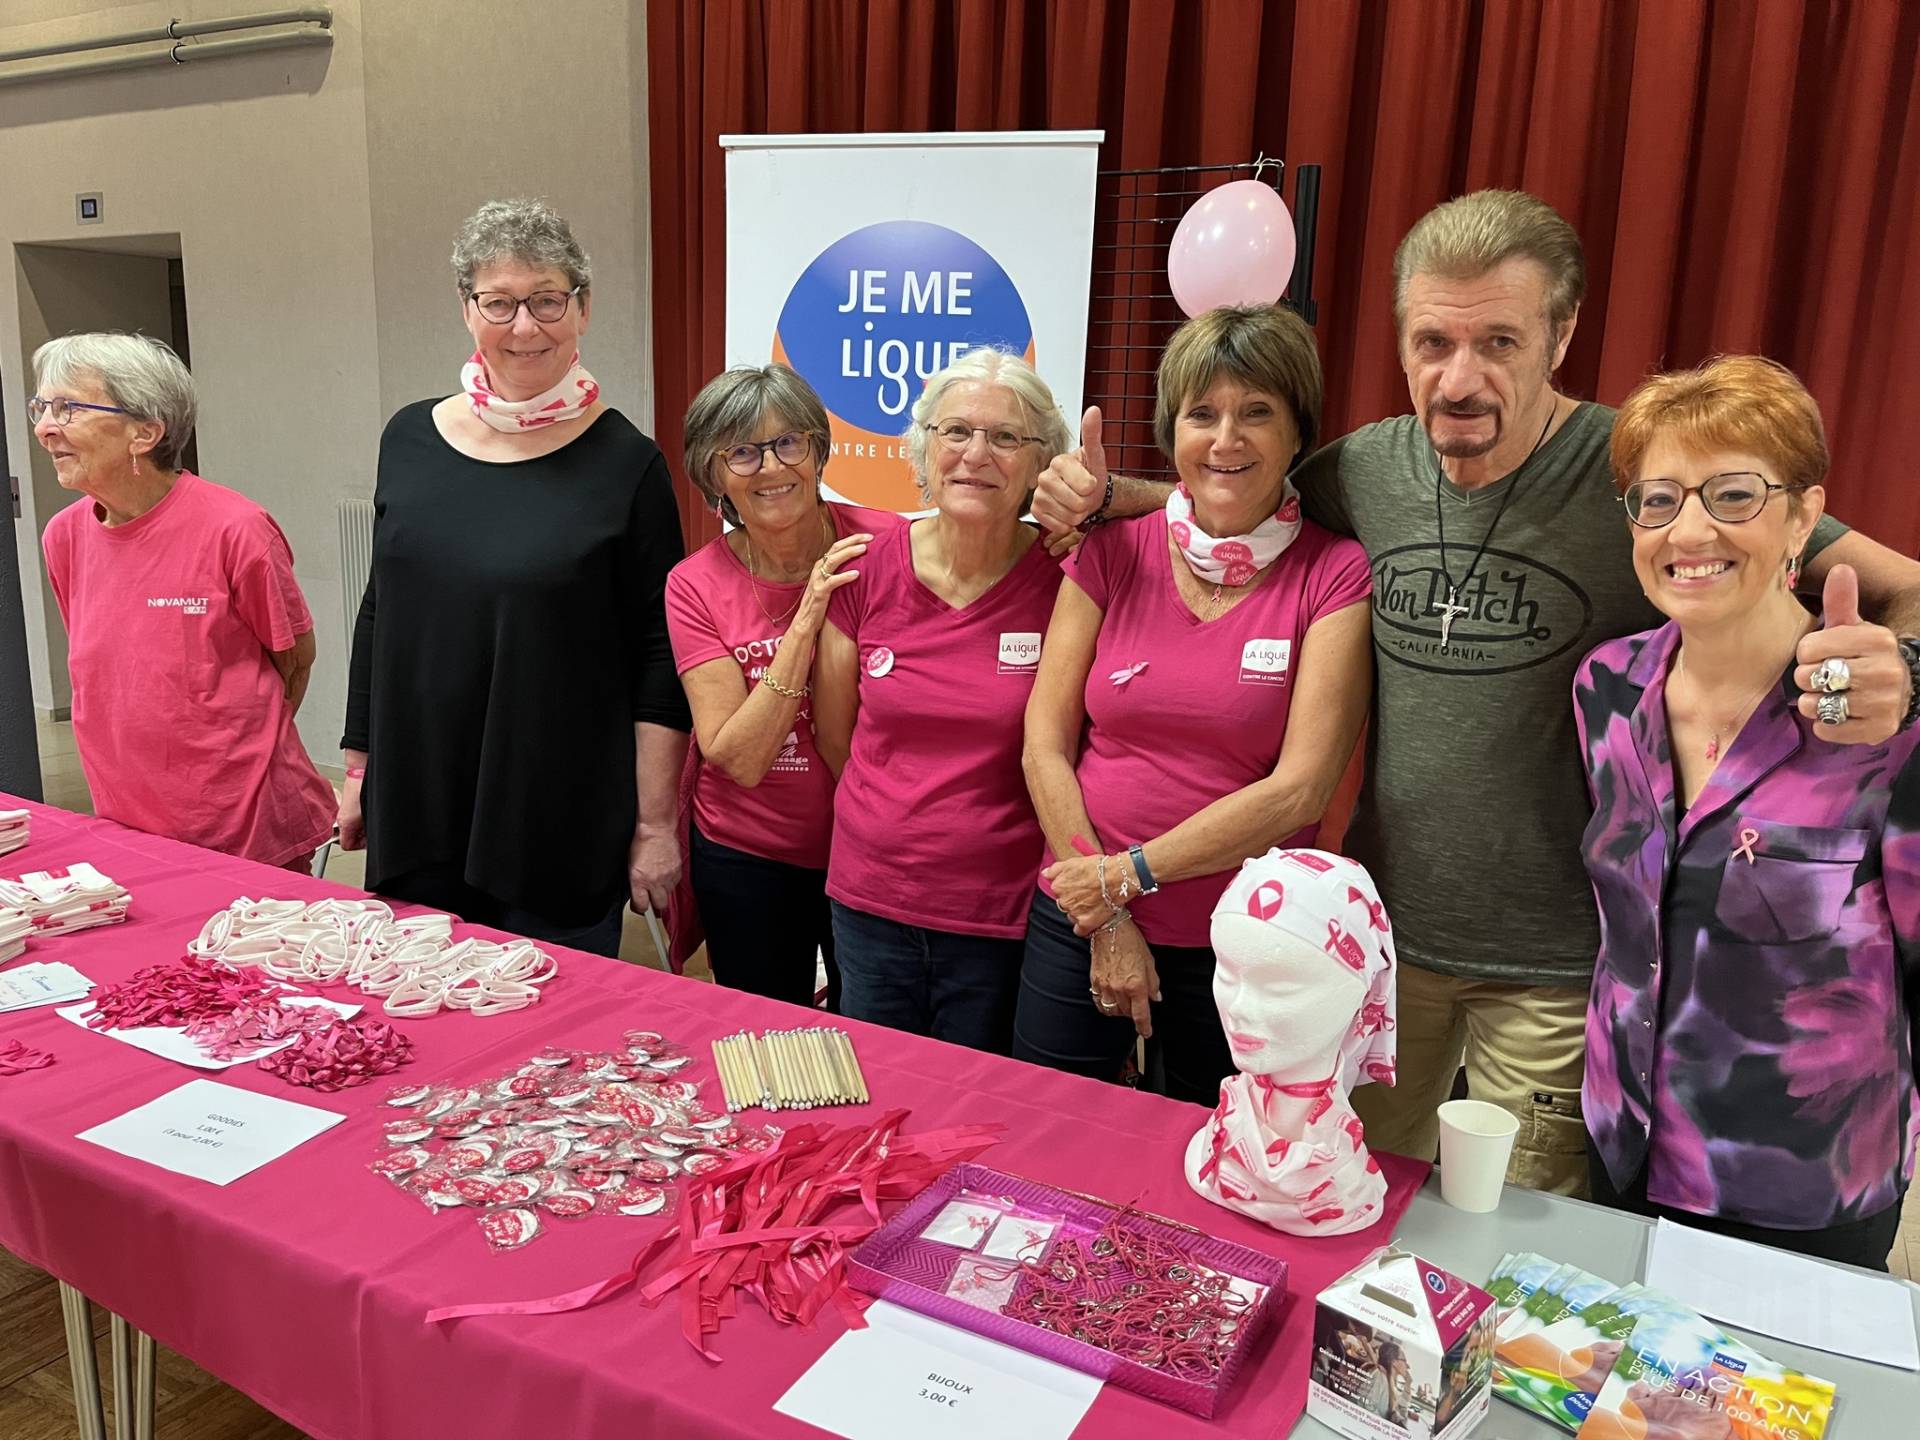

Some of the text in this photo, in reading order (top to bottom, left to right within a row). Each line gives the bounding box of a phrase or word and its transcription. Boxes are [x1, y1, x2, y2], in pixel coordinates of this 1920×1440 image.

[838, 270, 973, 315] JE ME
[829, 442, 908, 459] NTRE LE
[1375, 561, 1419, 621] Von
[147, 597, 209, 608] NOVAMUT
[1001, 644, 1012, 653] LA
[1245, 650, 1257, 659] LA
[207, 1113, 246, 1128] GOODIES
[1632, 1359, 1681, 1385] DEPUIS
[927, 1372, 974, 1395] BIJOUX
[1637, 1346, 1811, 1426] EN ACTION
[918, 1388, 959, 1408] 3,00 €
[1628, 1365, 1800, 1440] PLUS DE 100 ANS
